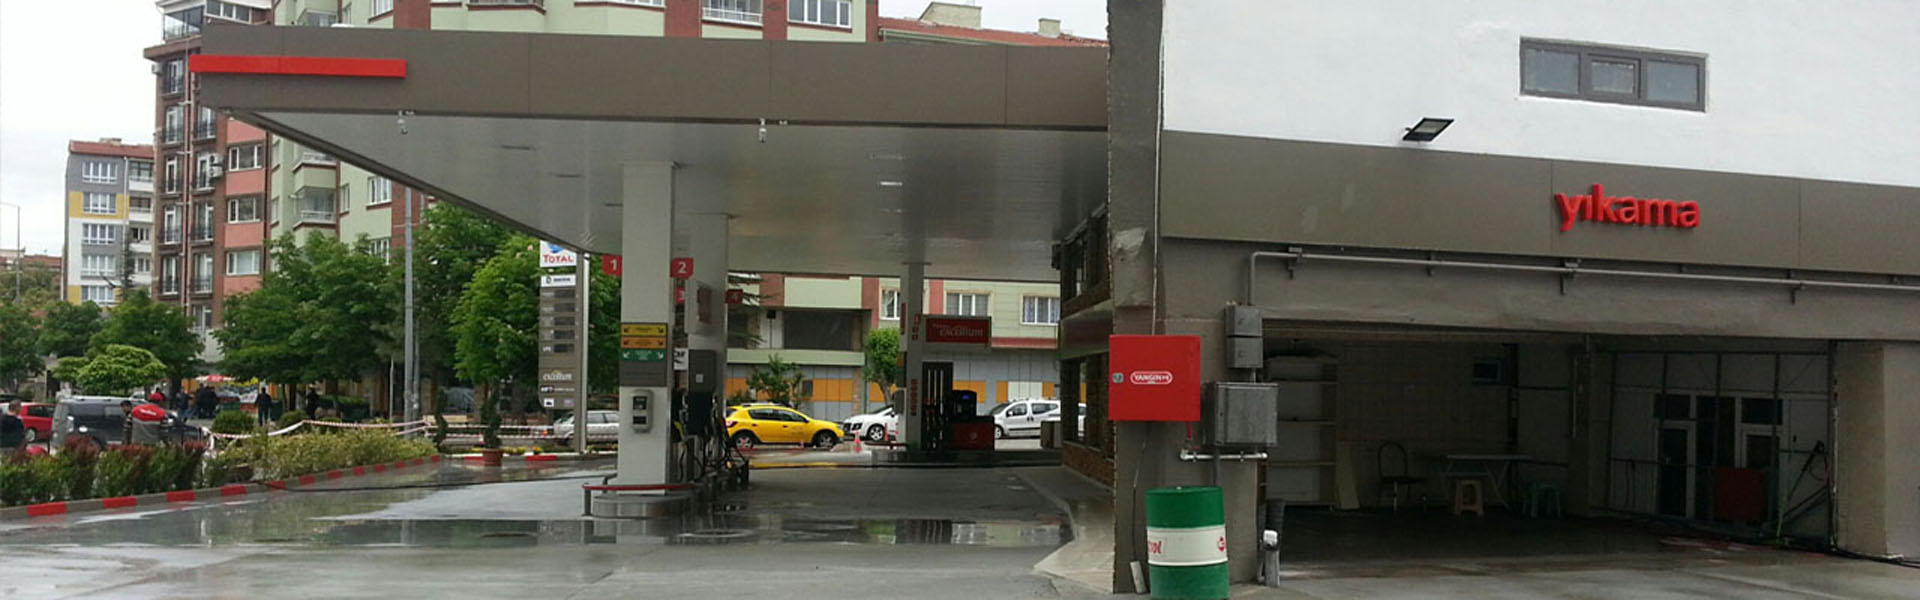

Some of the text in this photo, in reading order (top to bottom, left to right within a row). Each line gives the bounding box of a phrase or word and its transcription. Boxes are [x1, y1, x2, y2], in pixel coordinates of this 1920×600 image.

[1554, 183, 1700, 232] yıkama
[544, 254, 574, 263] TOTAL
[610, 259, 618, 271] 1
[678, 261, 687, 274] 2
